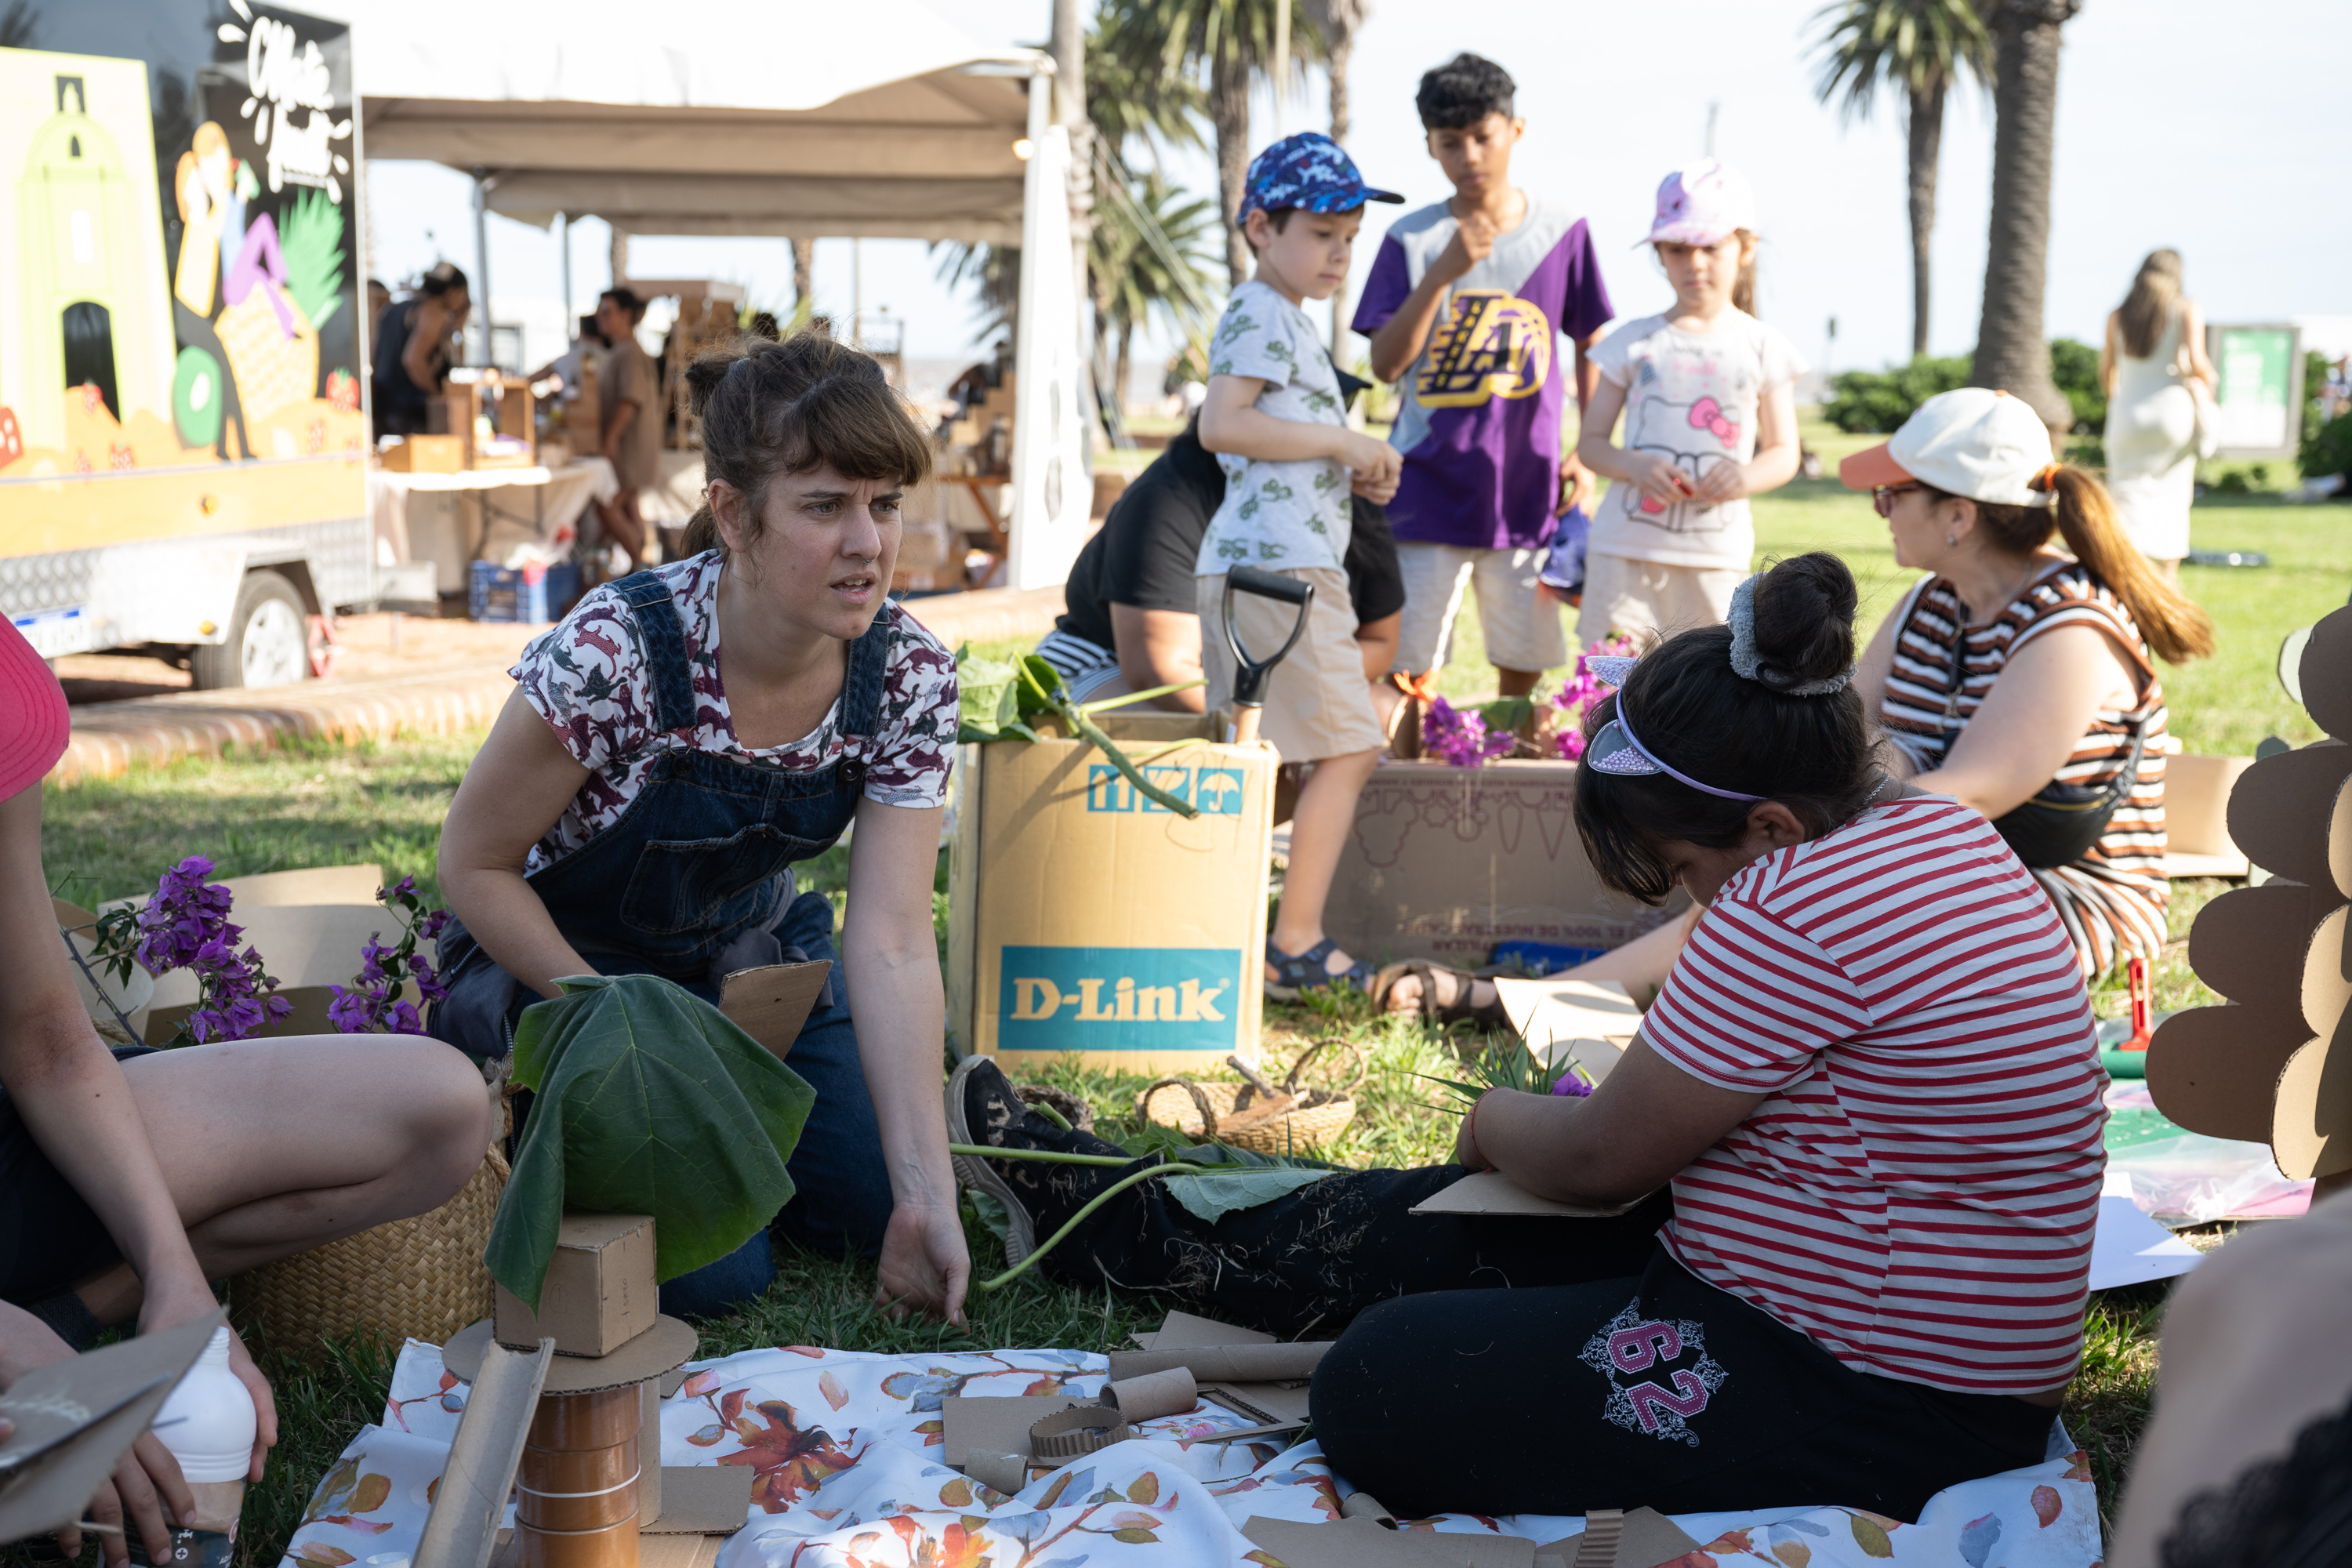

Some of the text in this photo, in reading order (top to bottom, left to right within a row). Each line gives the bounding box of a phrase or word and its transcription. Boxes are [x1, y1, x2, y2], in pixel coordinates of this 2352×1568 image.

[1435, 301, 1482, 388] LAKERS
[1538, 924, 1559, 938] DE
[1011, 977, 1226, 1022] D-Link
[1607, 1321, 1708, 1433] 62
